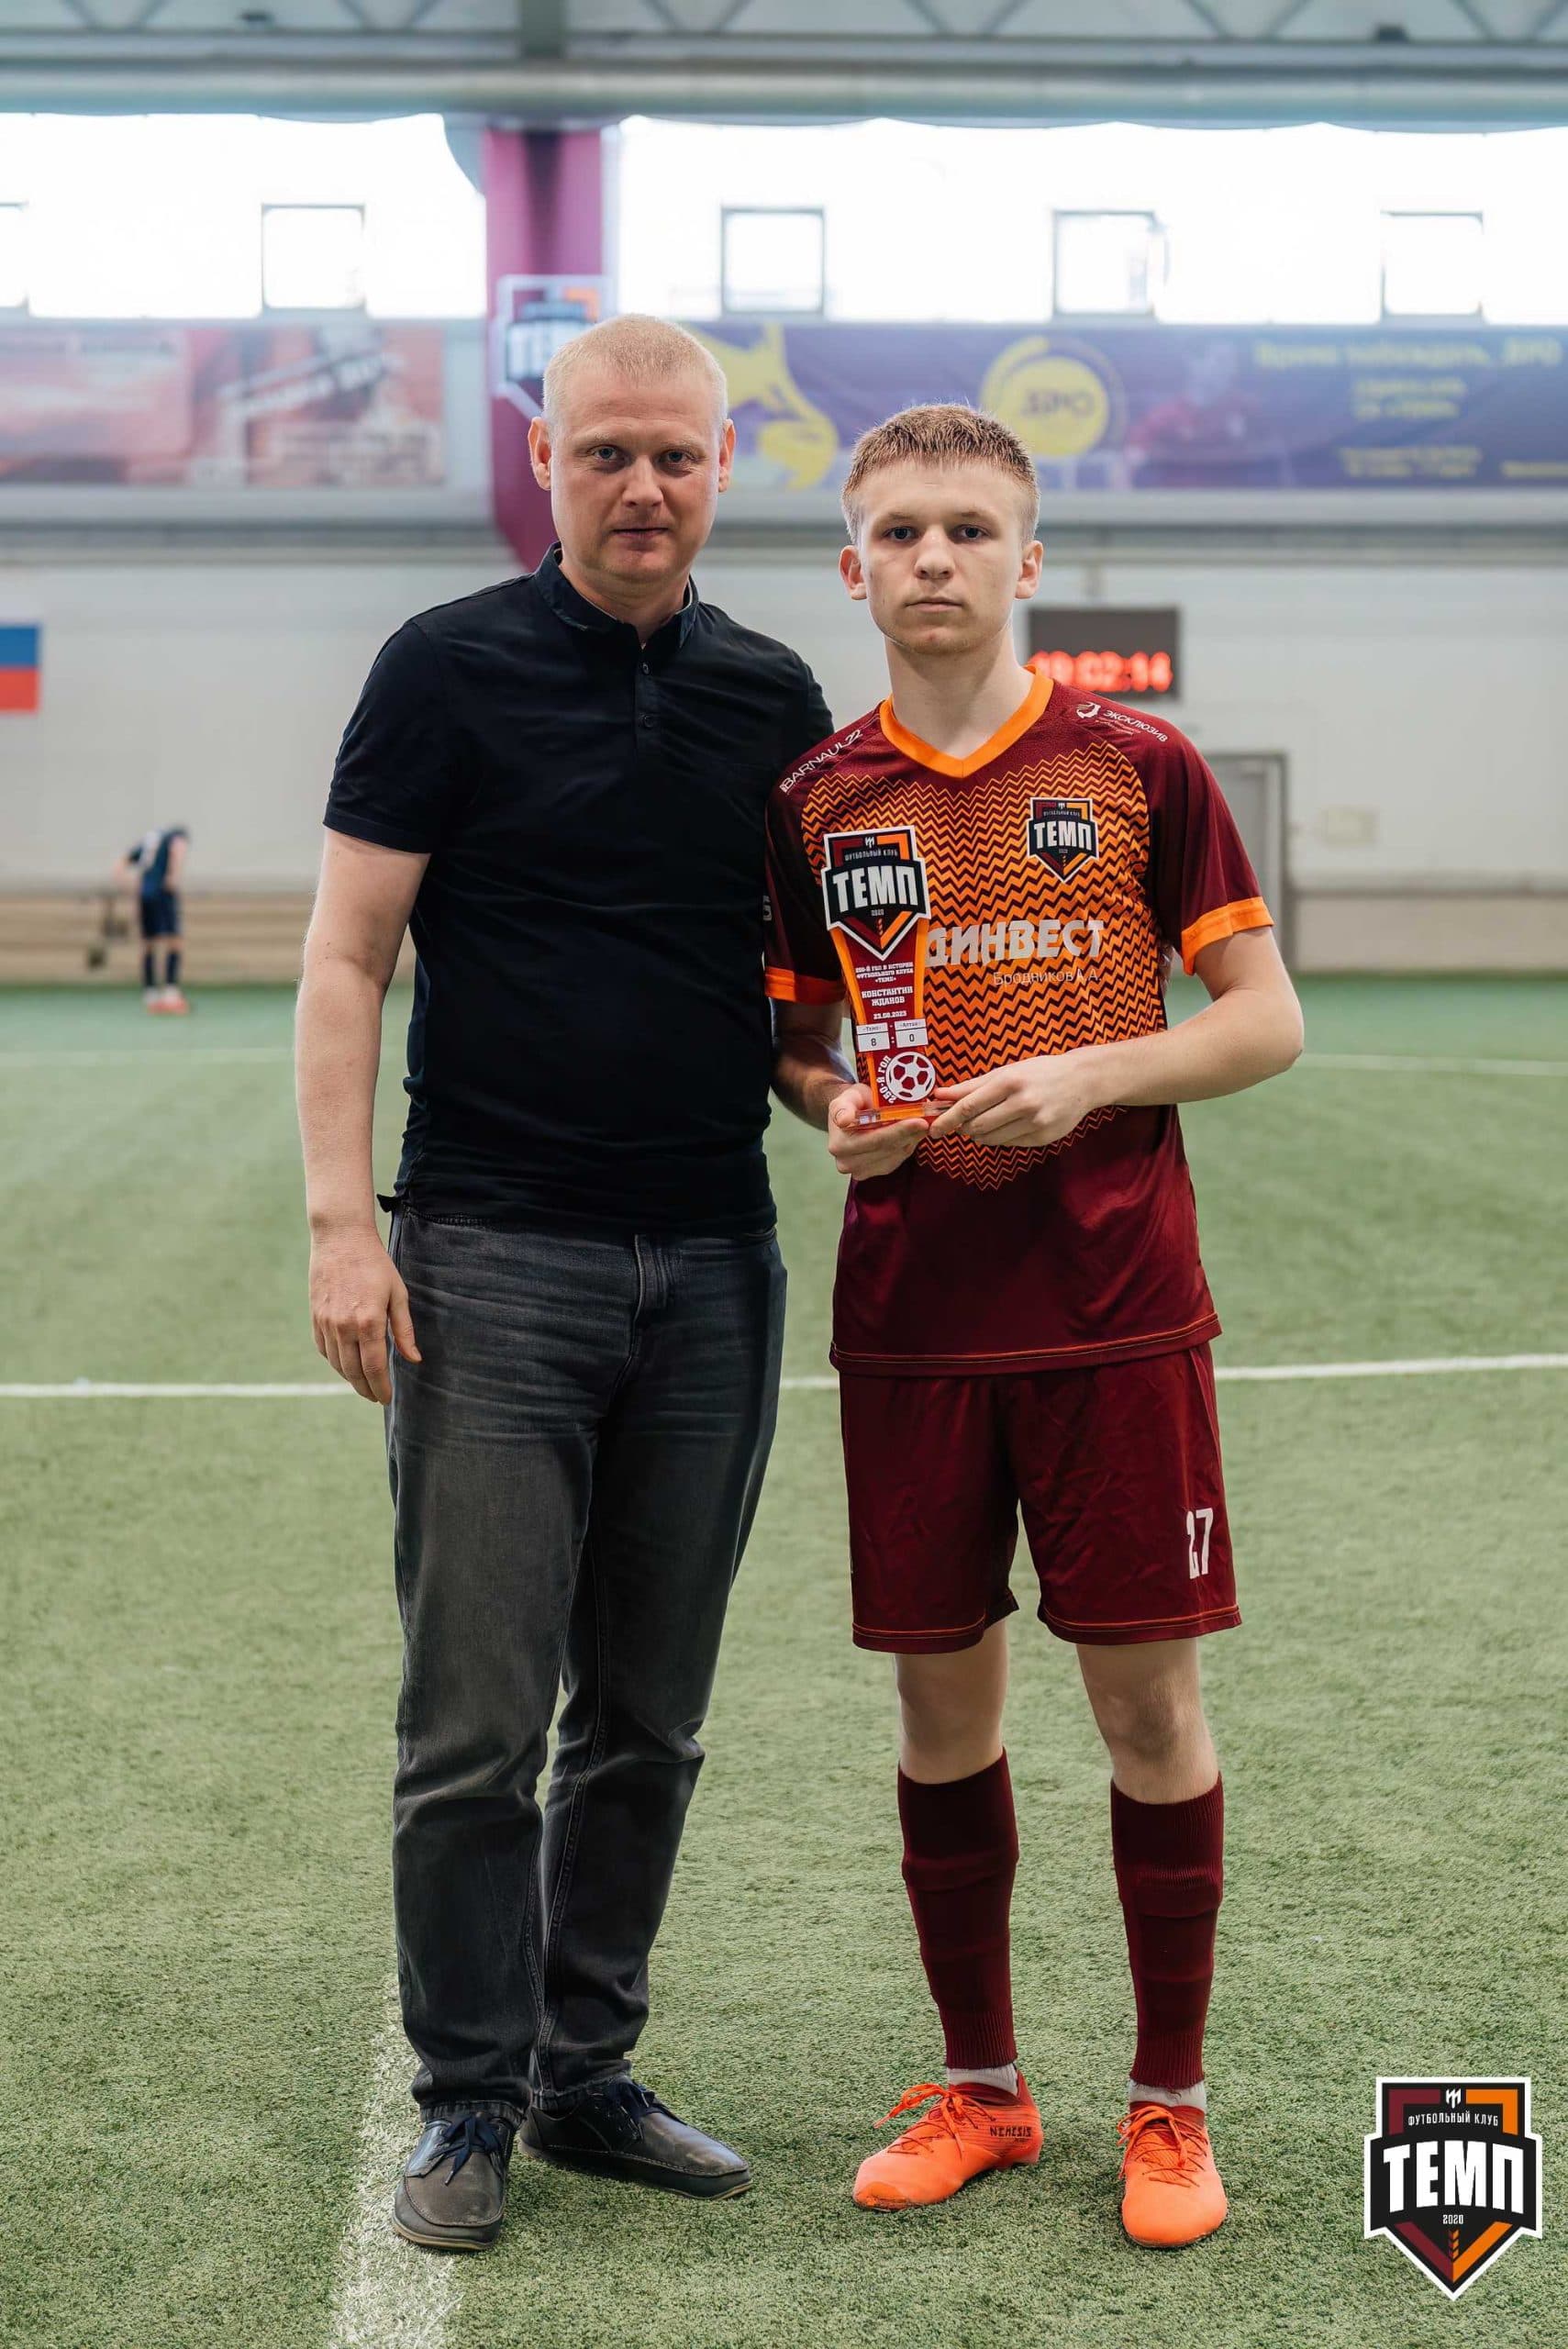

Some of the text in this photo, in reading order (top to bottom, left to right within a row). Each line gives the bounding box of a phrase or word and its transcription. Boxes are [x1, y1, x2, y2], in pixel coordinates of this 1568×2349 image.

[1104, 709, 1168, 742] ЭКСКЛЮЗИВ
[1034, 820, 1092, 851] ТЕМП
[832, 865, 917, 913] ТЕМП
[926, 918, 1104, 967] ДИНВЕСТ
[994, 971, 1073, 986] Бродников
[862, 986, 913, 998] КОНСТАНТИН
[872, 996, 905, 1007] ЖДАНОВ
[871, 1038, 877, 1046] 8
[909, 1033, 915, 1042] 0
[1186, 1508, 1213, 1579] 27
